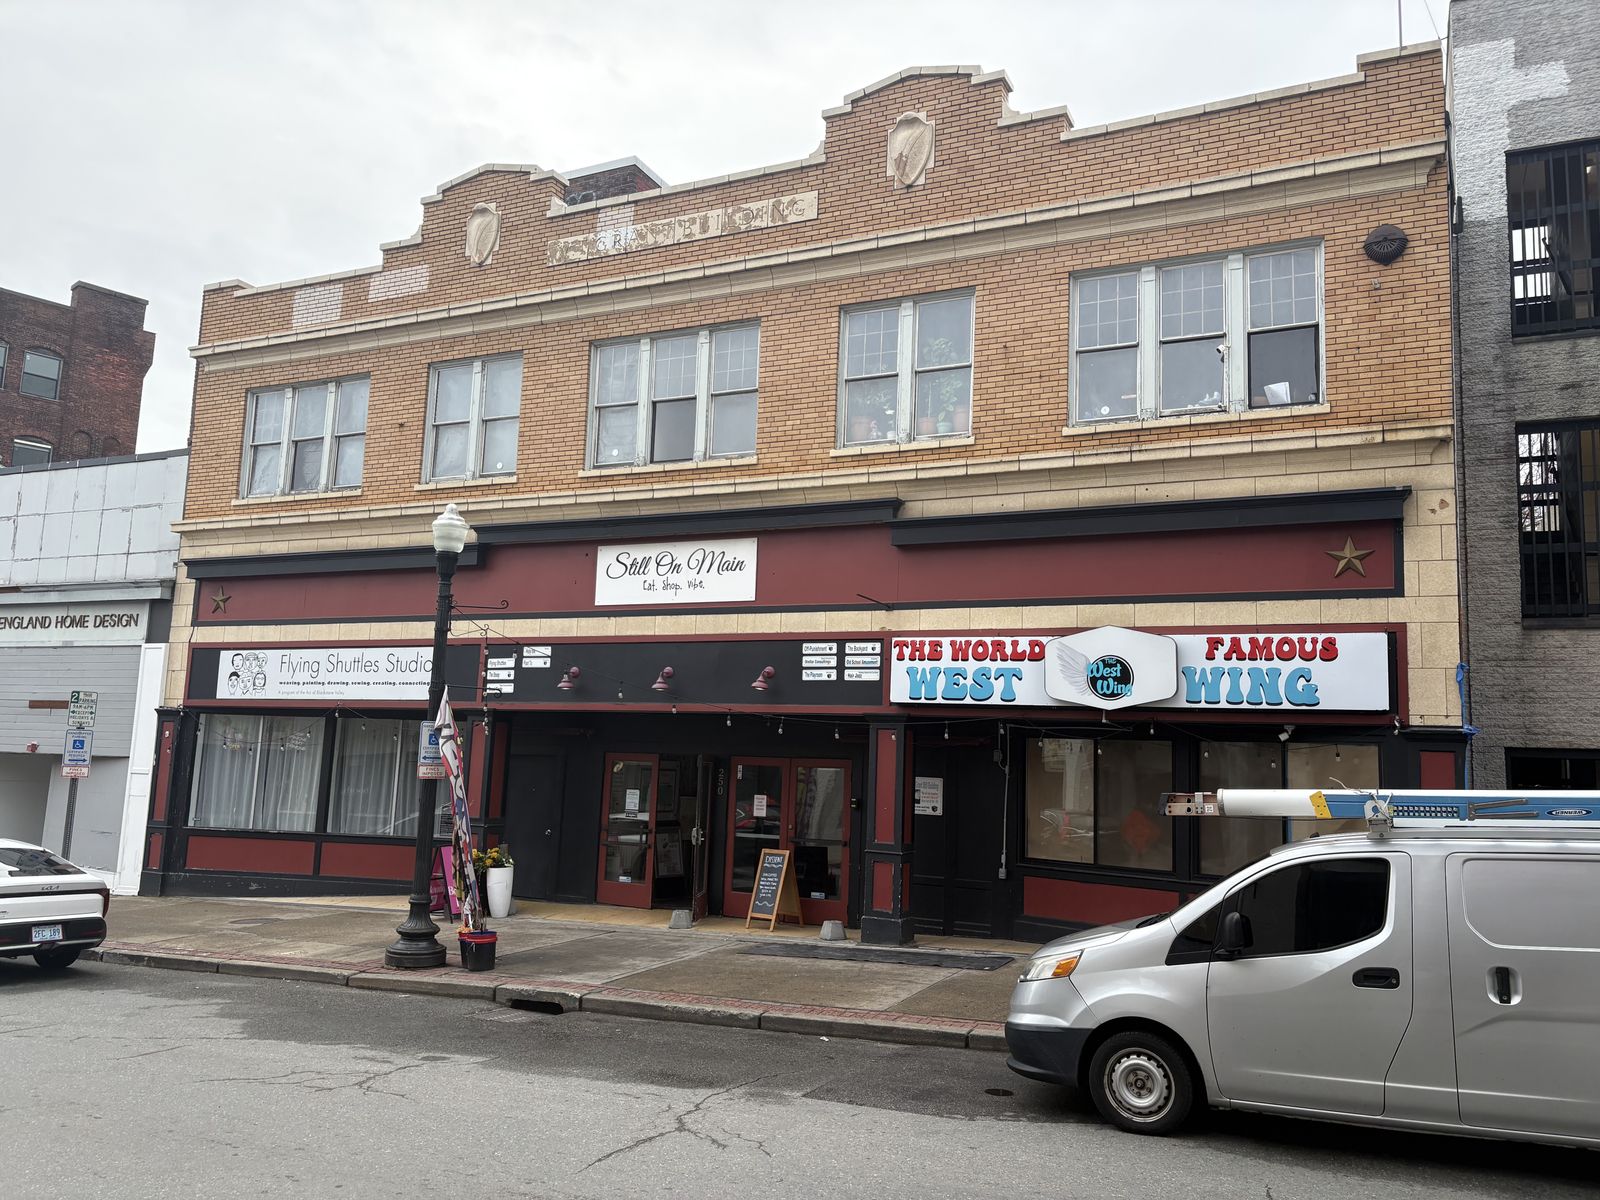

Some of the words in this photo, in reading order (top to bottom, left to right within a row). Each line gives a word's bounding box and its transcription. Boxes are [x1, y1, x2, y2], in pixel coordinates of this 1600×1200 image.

[682, 199, 806, 236] BUILDING
[606, 551, 652, 579] Still
[655, 551, 684, 576] On
[687, 548, 746, 576] Main
[0, 616, 51, 630] ENGLAND
[55, 615, 90, 629] HOME
[93, 613, 140, 628] DESIGN
[893, 640, 943, 661] THE
[950, 639, 1046, 662] WORLD
[1205, 636, 1339, 662] FAMOUS
[279, 653, 321, 679] Flying
[326, 651, 380, 673] Shuttles
[385, 651, 433, 673] Studio
[1087, 661, 1122, 677] West
[71, 692, 79, 703] 2
[906, 666, 1023, 702] WEST
[1181, 665, 1320, 706] WING
[1096, 677, 1133, 697] Wing
